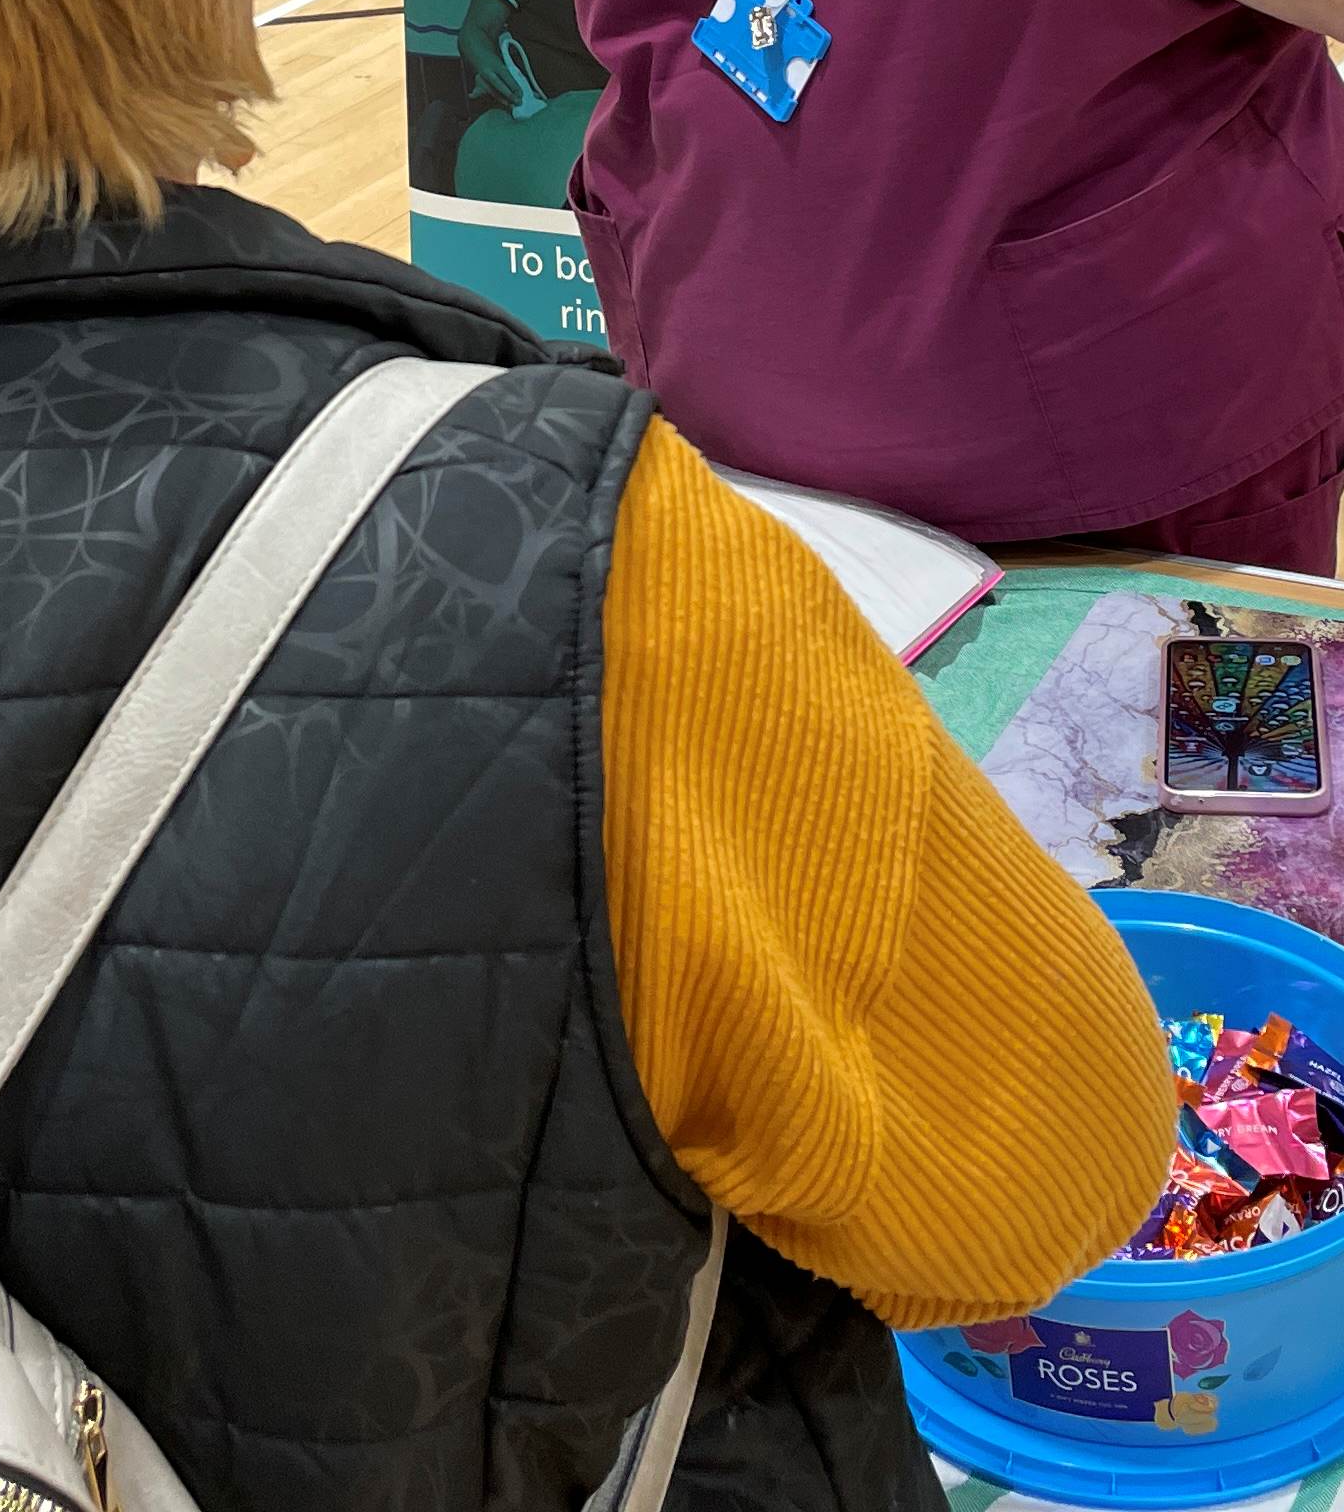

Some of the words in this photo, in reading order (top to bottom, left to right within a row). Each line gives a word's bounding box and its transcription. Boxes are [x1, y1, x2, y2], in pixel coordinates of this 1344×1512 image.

[501, 241, 543, 276] To
[555, 246, 594, 280] bo
[561, 299, 605, 334] rin
[1309, 1061, 1342, 1082] HAZEL
[1038, 1359, 1137, 1392] ROSES
